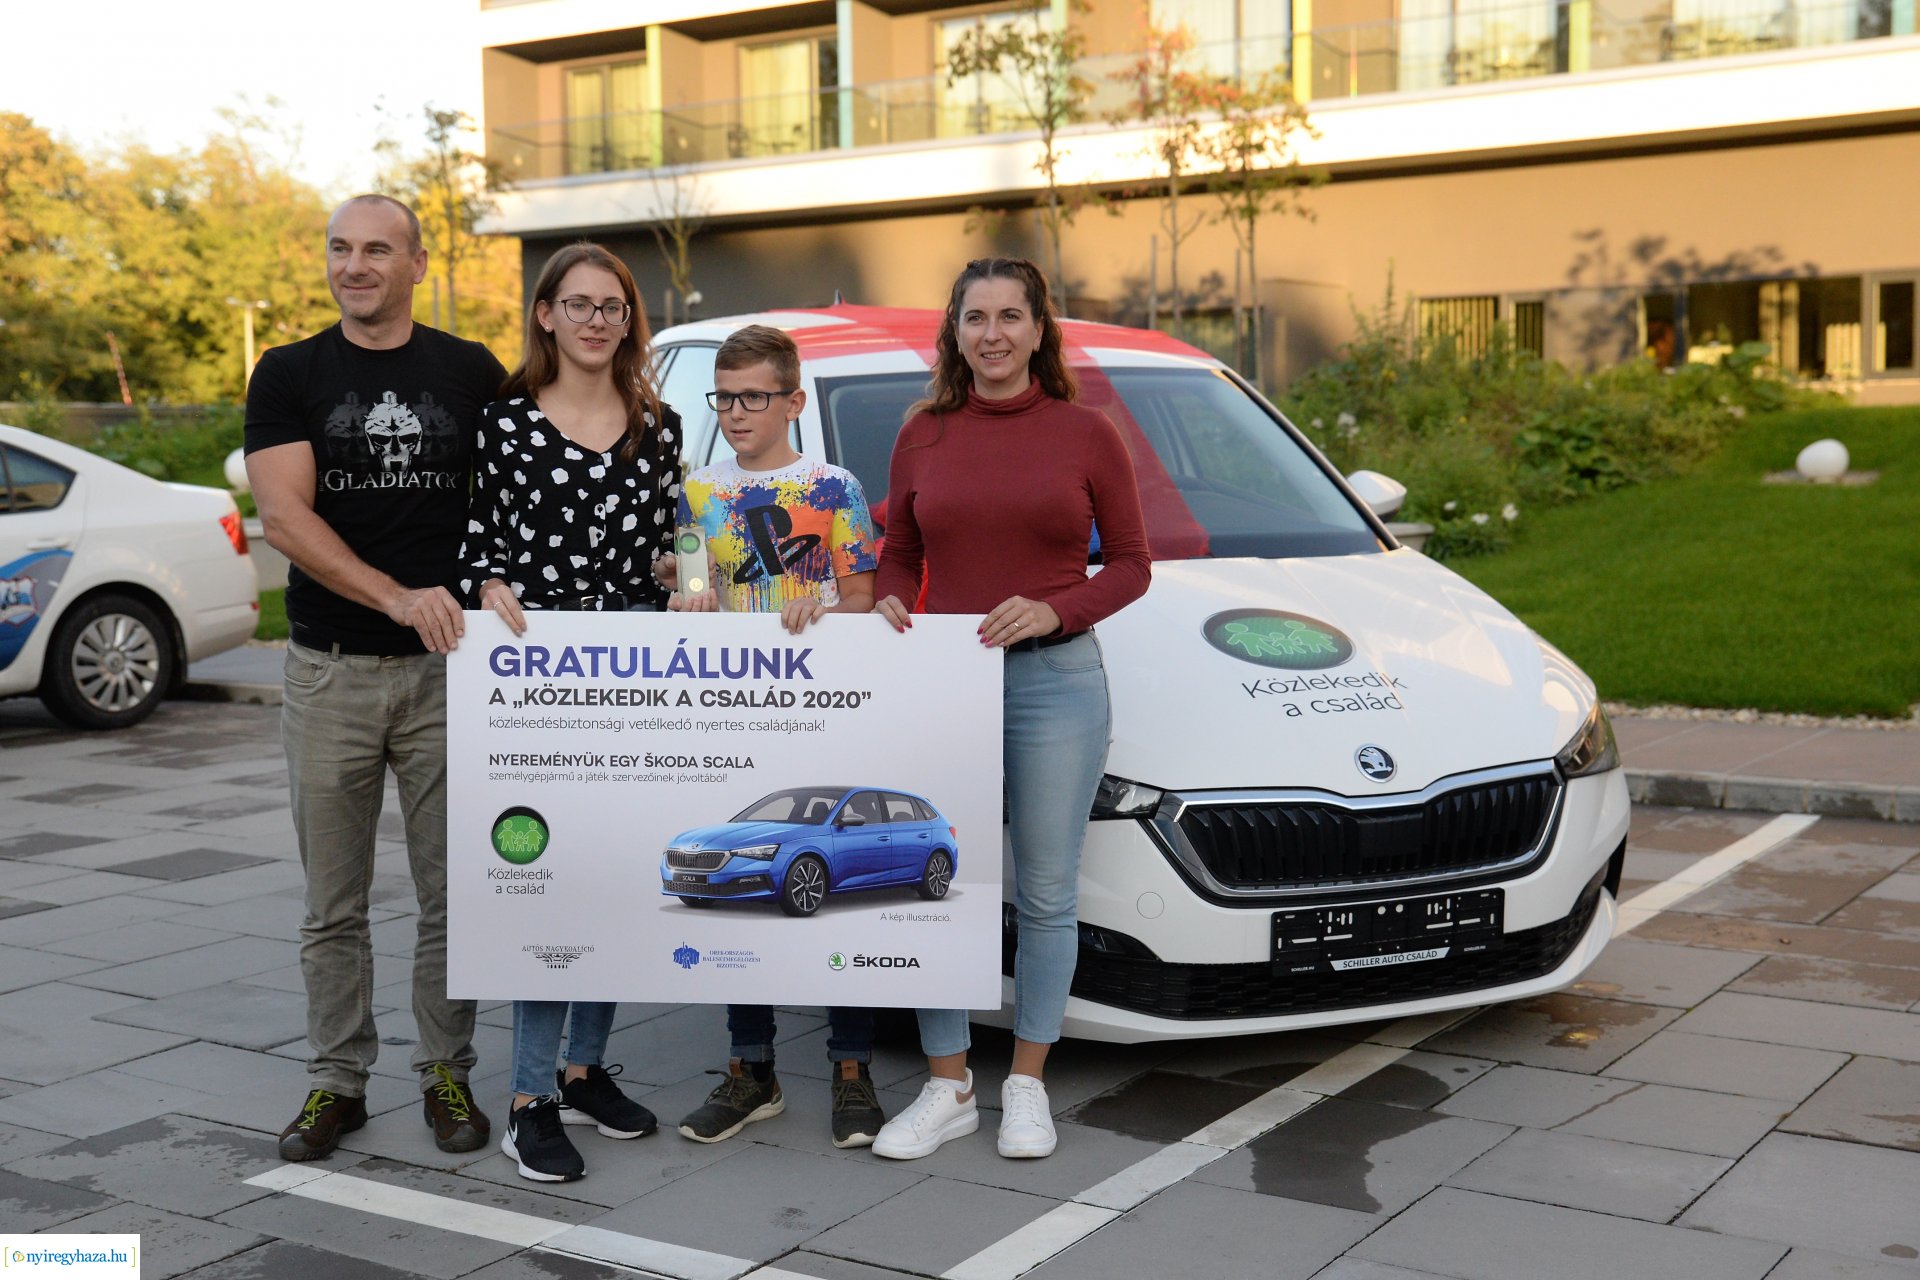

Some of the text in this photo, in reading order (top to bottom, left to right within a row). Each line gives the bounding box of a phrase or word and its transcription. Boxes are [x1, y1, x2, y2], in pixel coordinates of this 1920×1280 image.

[489, 638, 814, 680] GRATULÁLUNK
[1242, 672, 1408, 698] Közlekedik
[488, 688, 506, 705] A
[675, 690, 693, 707] A
[700, 686, 796, 708] CSALÁD
[1283, 692, 1405, 717] a család
[489, 716, 825, 734] közlekedésbiztonsági vetélkedő nyertes családjának!
[489, 751, 755, 768] NYEREMÉNYÜK EGY ŠKODA SCALA
[489, 771, 575, 783] személygépjármű
[584, 771, 609, 783] játék
[612, 773, 674, 782] szervezőinek
[487, 868, 554, 880] Közlekedik
[495, 883, 545, 895] a család
[880, 912, 887, 920] A
[889, 913, 905, 922] kép
[853, 954, 921, 968] ŠKODA
[1343, 957, 1380, 969] SCHILLER
